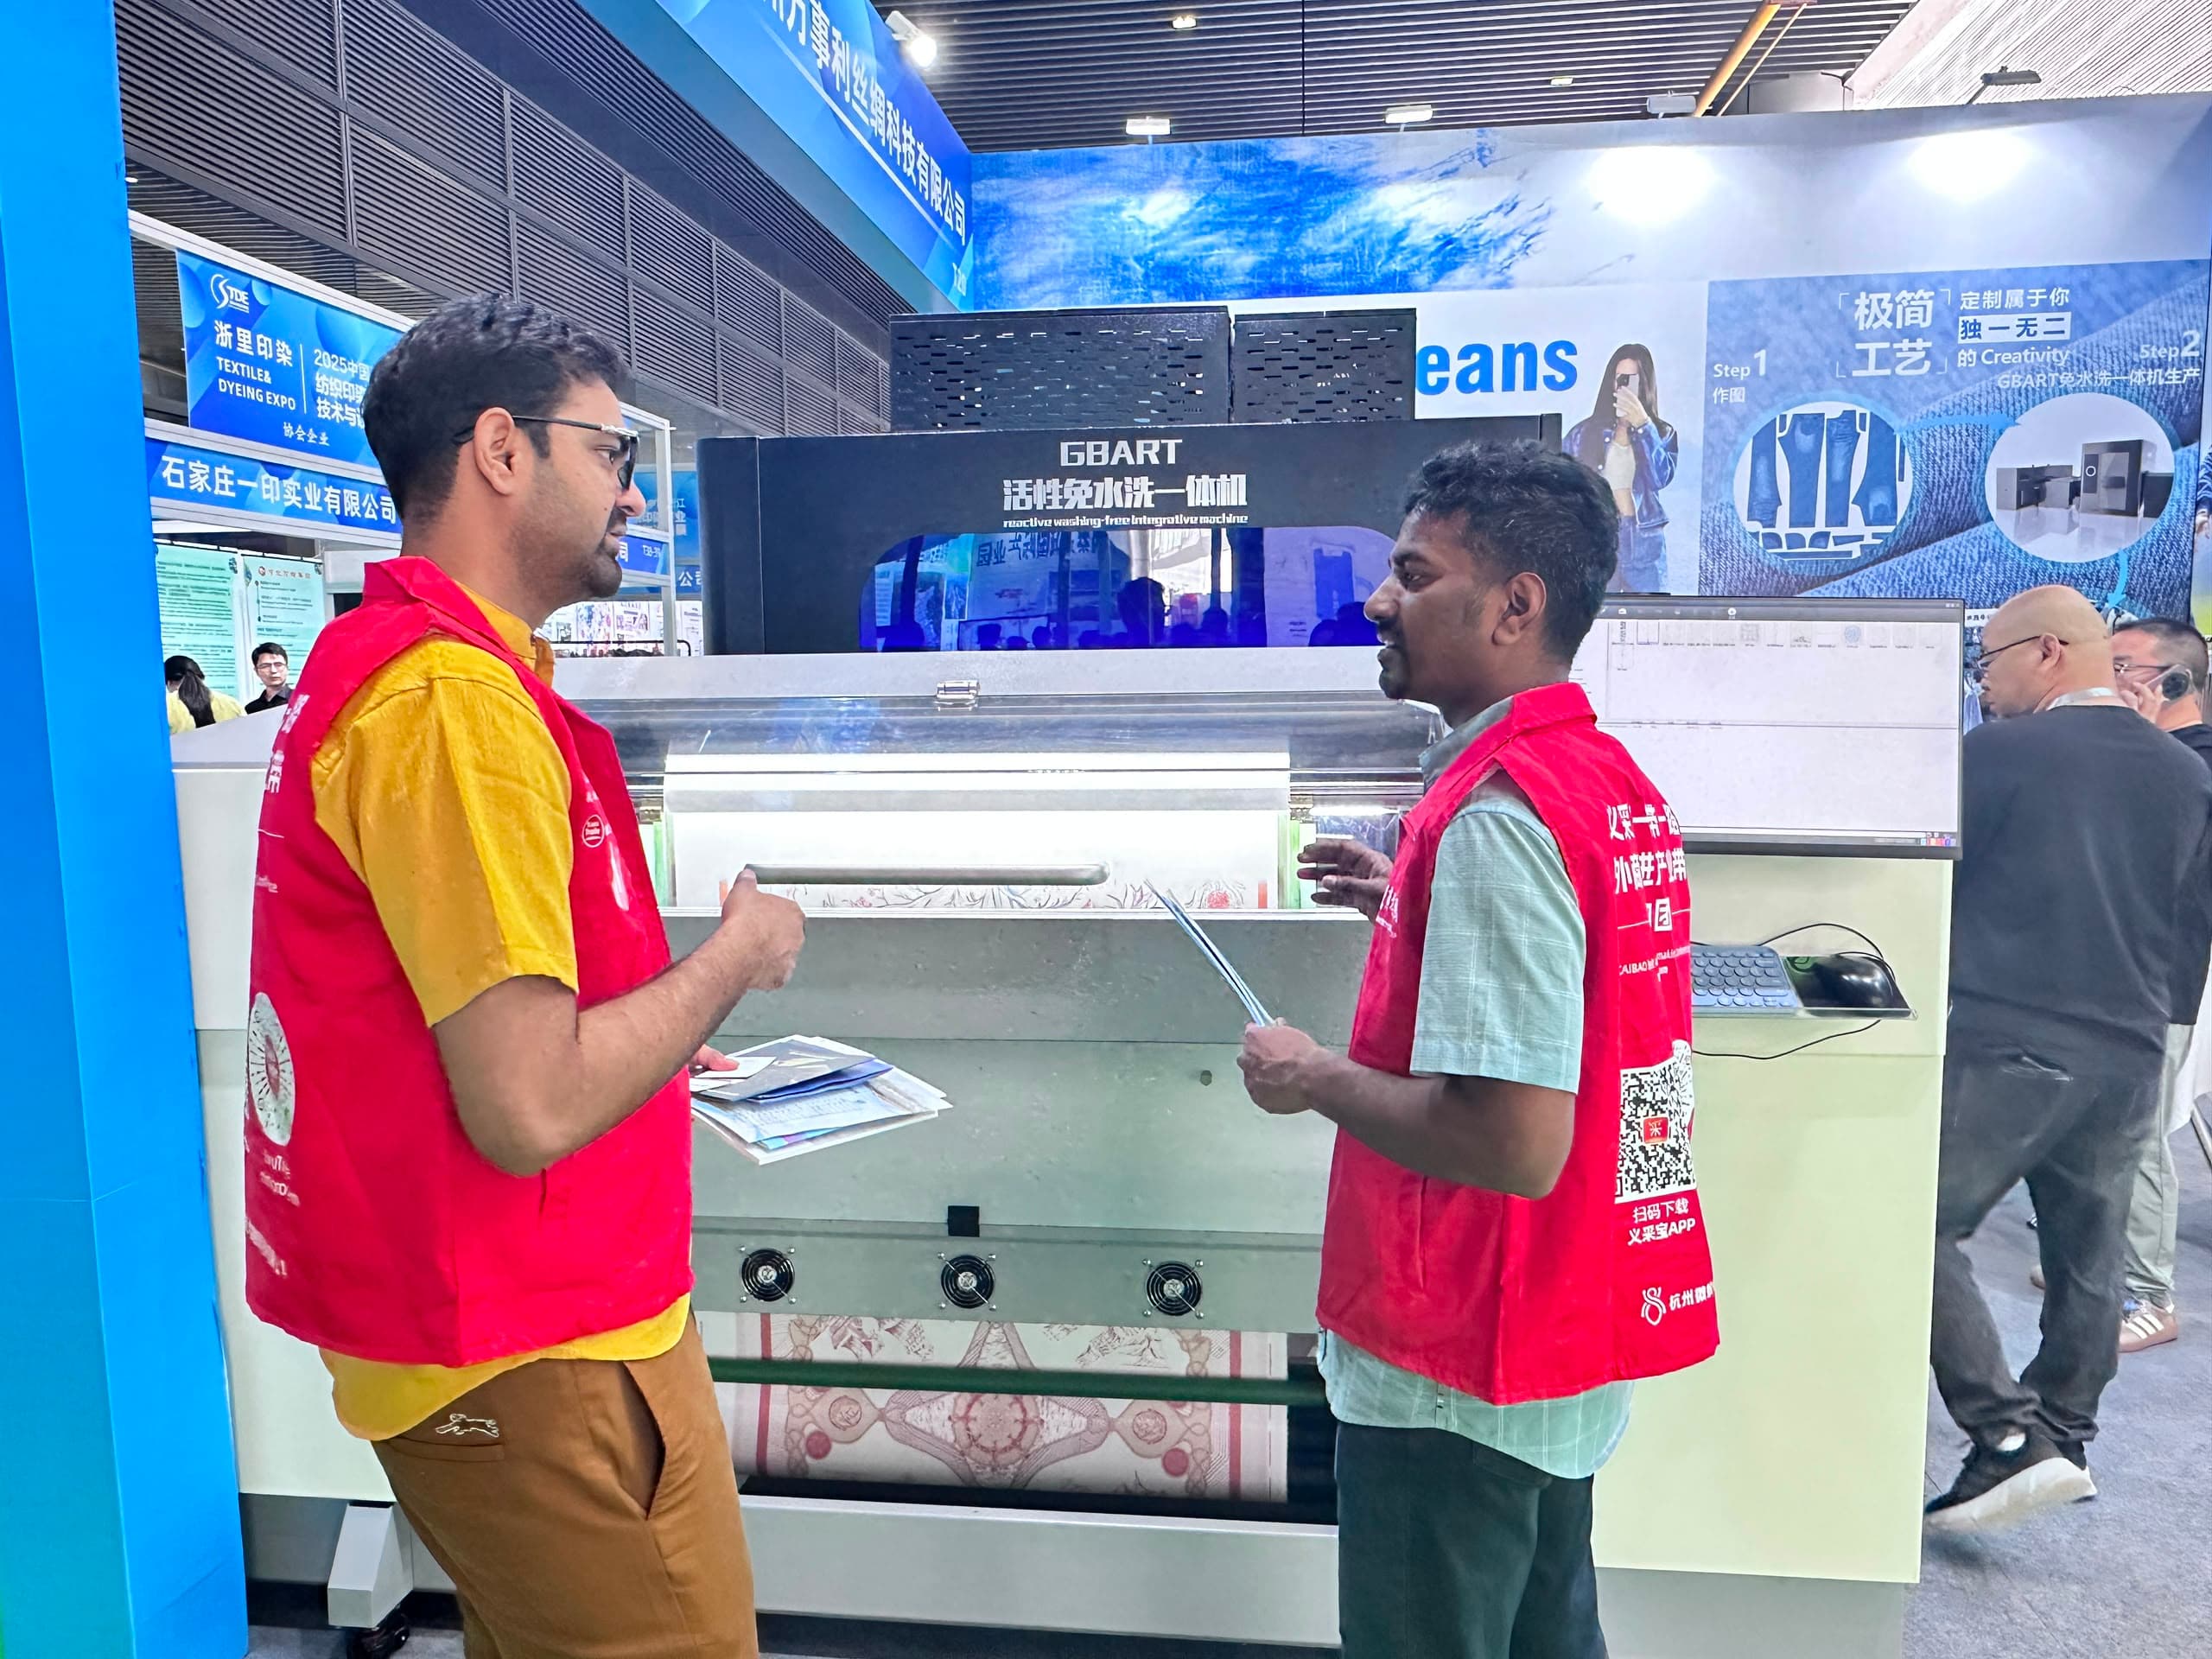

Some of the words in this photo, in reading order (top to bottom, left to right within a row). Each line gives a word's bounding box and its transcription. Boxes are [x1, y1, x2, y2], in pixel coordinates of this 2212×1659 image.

[762, 0, 965, 246] 万事利丝绸科技有限公司
[1854, 289, 1936, 331] 极简
[1960, 287, 2070, 310] 定制属于你
[1960, 317, 2066, 340] 独一无二
[214, 321, 293, 367] 浙里印染
[1852, 338, 1933, 377] 工艺
[1957, 348, 1977, 367] 的
[1980, 346, 2071, 366] Creativity
[217, 356, 272, 384] TEXTILE&
[218, 378, 264, 403] DYEING
[266, 391, 296, 410] EXPO
[1713, 387, 1746, 404] 作图
[283, 422, 330, 447] 协会企业
[1060, 439, 1183, 467] GBART
[161, 455, 397, 524] 石家庄一印实业有限公司
[1003, 474, 1248, 511] 活性免水洗一体机
[1199, 512, 1248, 524] machine
[1632, 1198, 1689, 1224] 扫码下载
[1627, 1217, 1696, 1246] 义采宝APP
